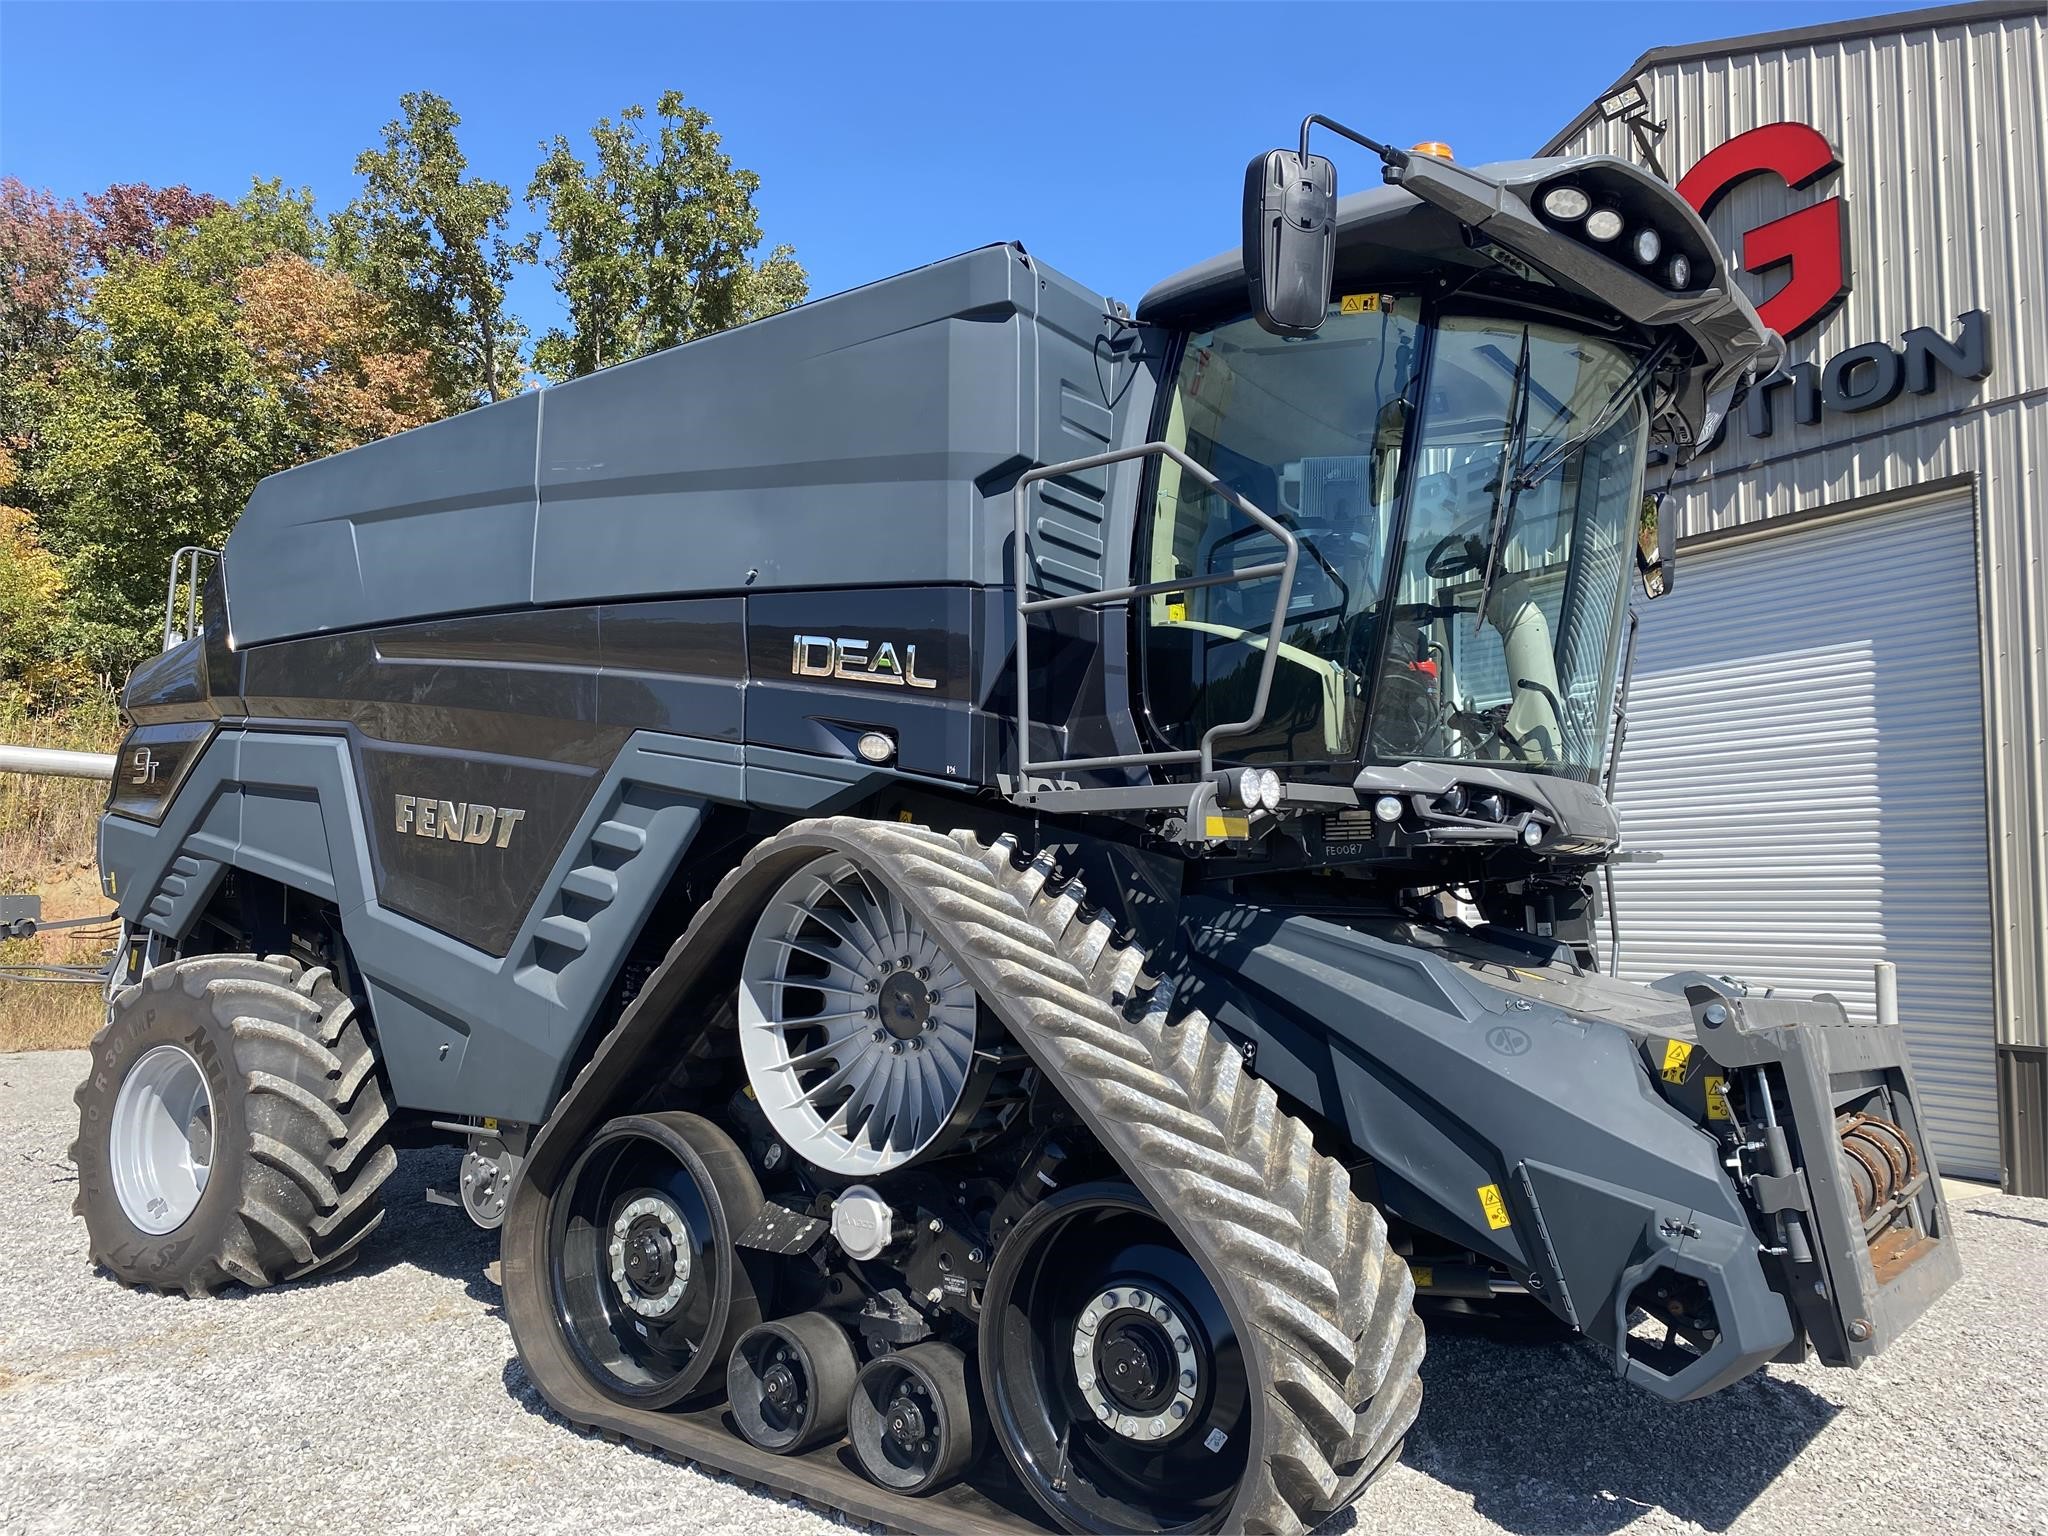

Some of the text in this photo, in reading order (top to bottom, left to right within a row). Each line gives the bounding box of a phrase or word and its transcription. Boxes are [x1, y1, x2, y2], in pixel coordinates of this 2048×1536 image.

[1674, 121, 1852, 341] G
[1700, 308, 1993, 455] TION
[792, 634, 937, 689] IDEAL
[132, 747, 159, 784] 9T
[395, 794, 526, 849] FENDT
[95, 1072, 108, 1093] R
[105, 1036, 125, 1068] 30
[127, 1008, 158, 1040] IMP
